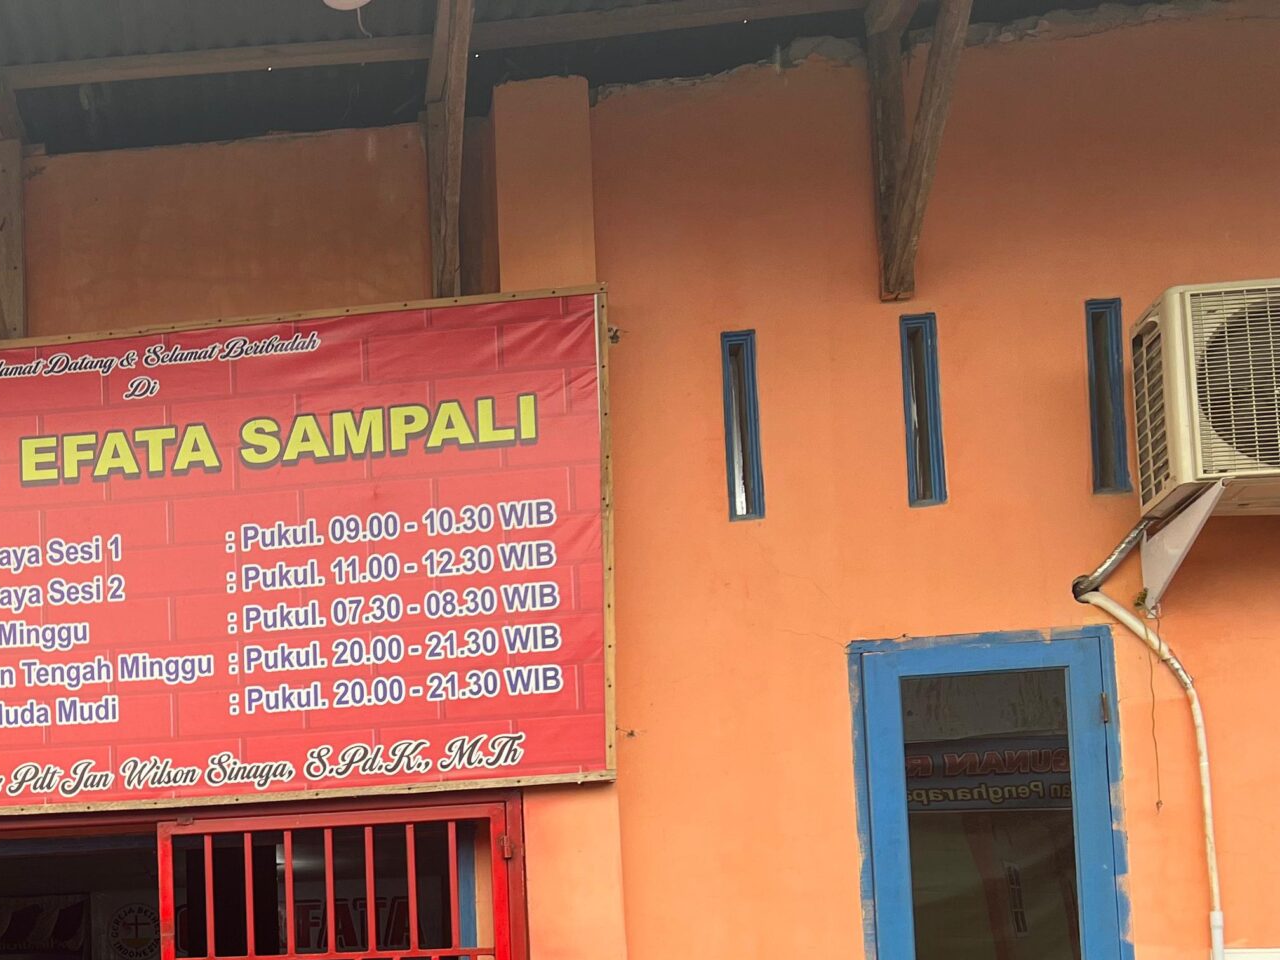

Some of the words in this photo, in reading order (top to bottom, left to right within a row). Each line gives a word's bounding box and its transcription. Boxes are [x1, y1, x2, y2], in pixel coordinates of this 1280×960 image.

[43, 354, 116, 376] Datang
[120, 351, 136, 368] &
[144, 344, 217, 366] Selamat
[220, 332, 320, 360] Beribadah
[124, 378, 159, 399] Di
[20, 423, 220, 484] EFATA
[240, 394, 537, 465] SAMPALI
[242, 520, 322, 549] Pukul.
[330, 513, 398, 542] 09.00
[424, 506, 493, 535] 10.30
[500, 501, 556, 528] WIB
[48, 538, 101, 564] Sesi
[110, 537, 121, 560] 1
[243, 561, 324, 590] Pukul.
[332, 554, 398, 583] 11.00
[424, 547, 493, 576] 12.30
[500, 542, 556, 569] WIB
[49, 578, 101, 604] Sesi
[109, 577, 124, 601] 2
[244, 602, 325, 631] Pukul.
[332, 596, 401, 624] 07.30
[426, 589, 495, 618] 08.30
[503, 583, 559, 610] WIB
[22, 659, 111, 690] Tengah
[119, 653, 213, 683] Minggu
[245, 643, 326, 672] Pukul.
[332, 637, 402, 665] 20.00
[427, 630, 497, 659] 21.30
[504, 624, 561, 652] WIB
[57, 698, 118, 723] Mudi
[246, 684, 327, 713] Pukul.
[333, 678, 403, 706] 20.00
[428, 671, 499, 700] 21.30
[505, 666, 563, 693] WIB
[7, 763, 61, 797] Pdt
[60, 759, 114, 793] Jan
[119, 755, 200, 788] Wilson
[205, 752, 294, 790] Sinaga,
[439, 731, 524, 771] M.Th
